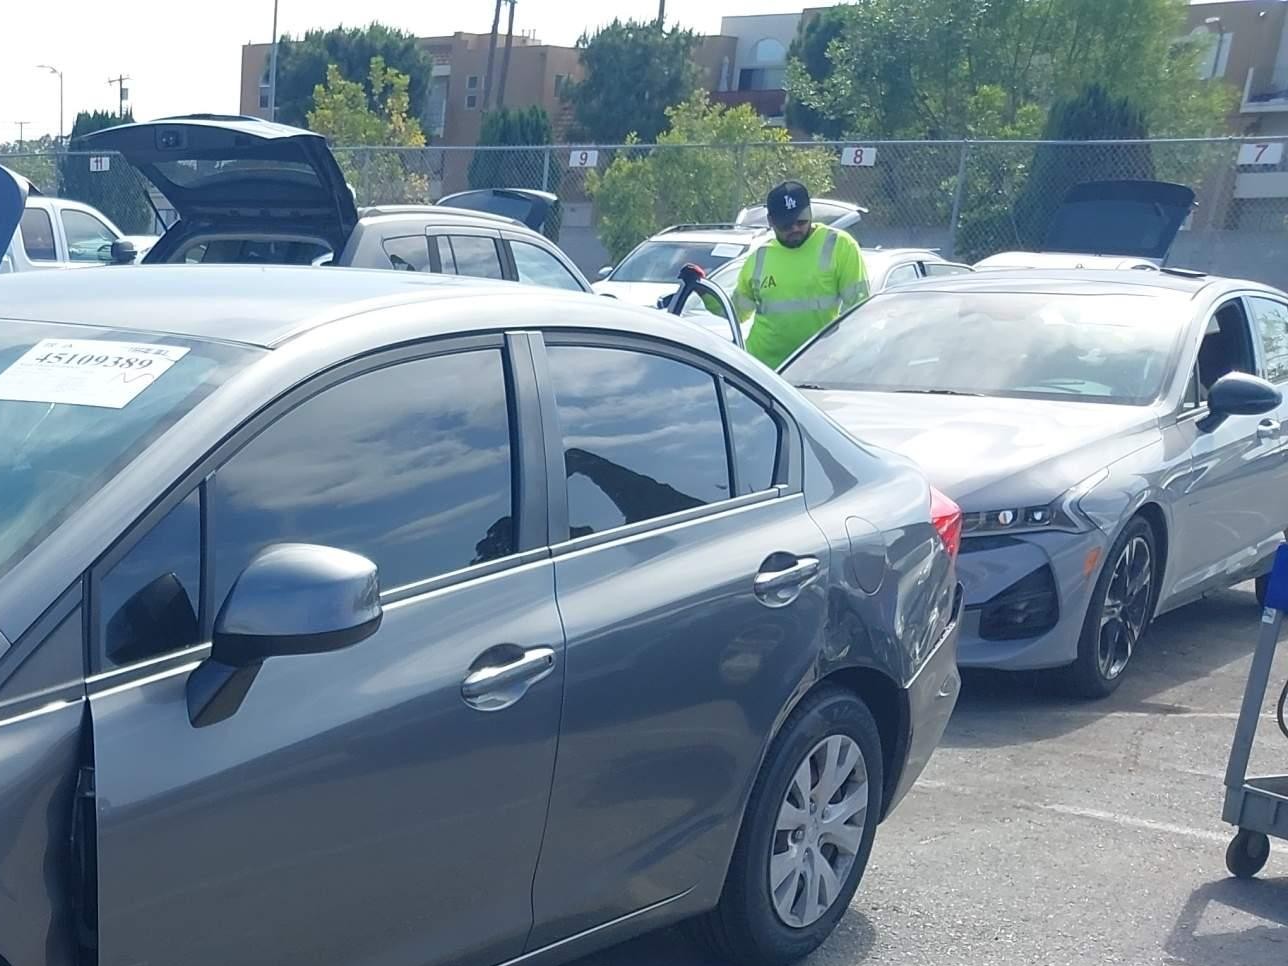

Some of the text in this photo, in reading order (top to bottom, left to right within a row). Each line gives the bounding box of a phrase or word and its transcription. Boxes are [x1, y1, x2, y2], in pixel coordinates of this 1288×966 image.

[579, 151, 588, 166] 9
[853, 148, 864, 165] 8
[1255, 144, 1269, 162] 7
[93, 157, 104, 170] 11
[783, 195, 797, 210] LA
[34, 352, 154, 370] 45109389
